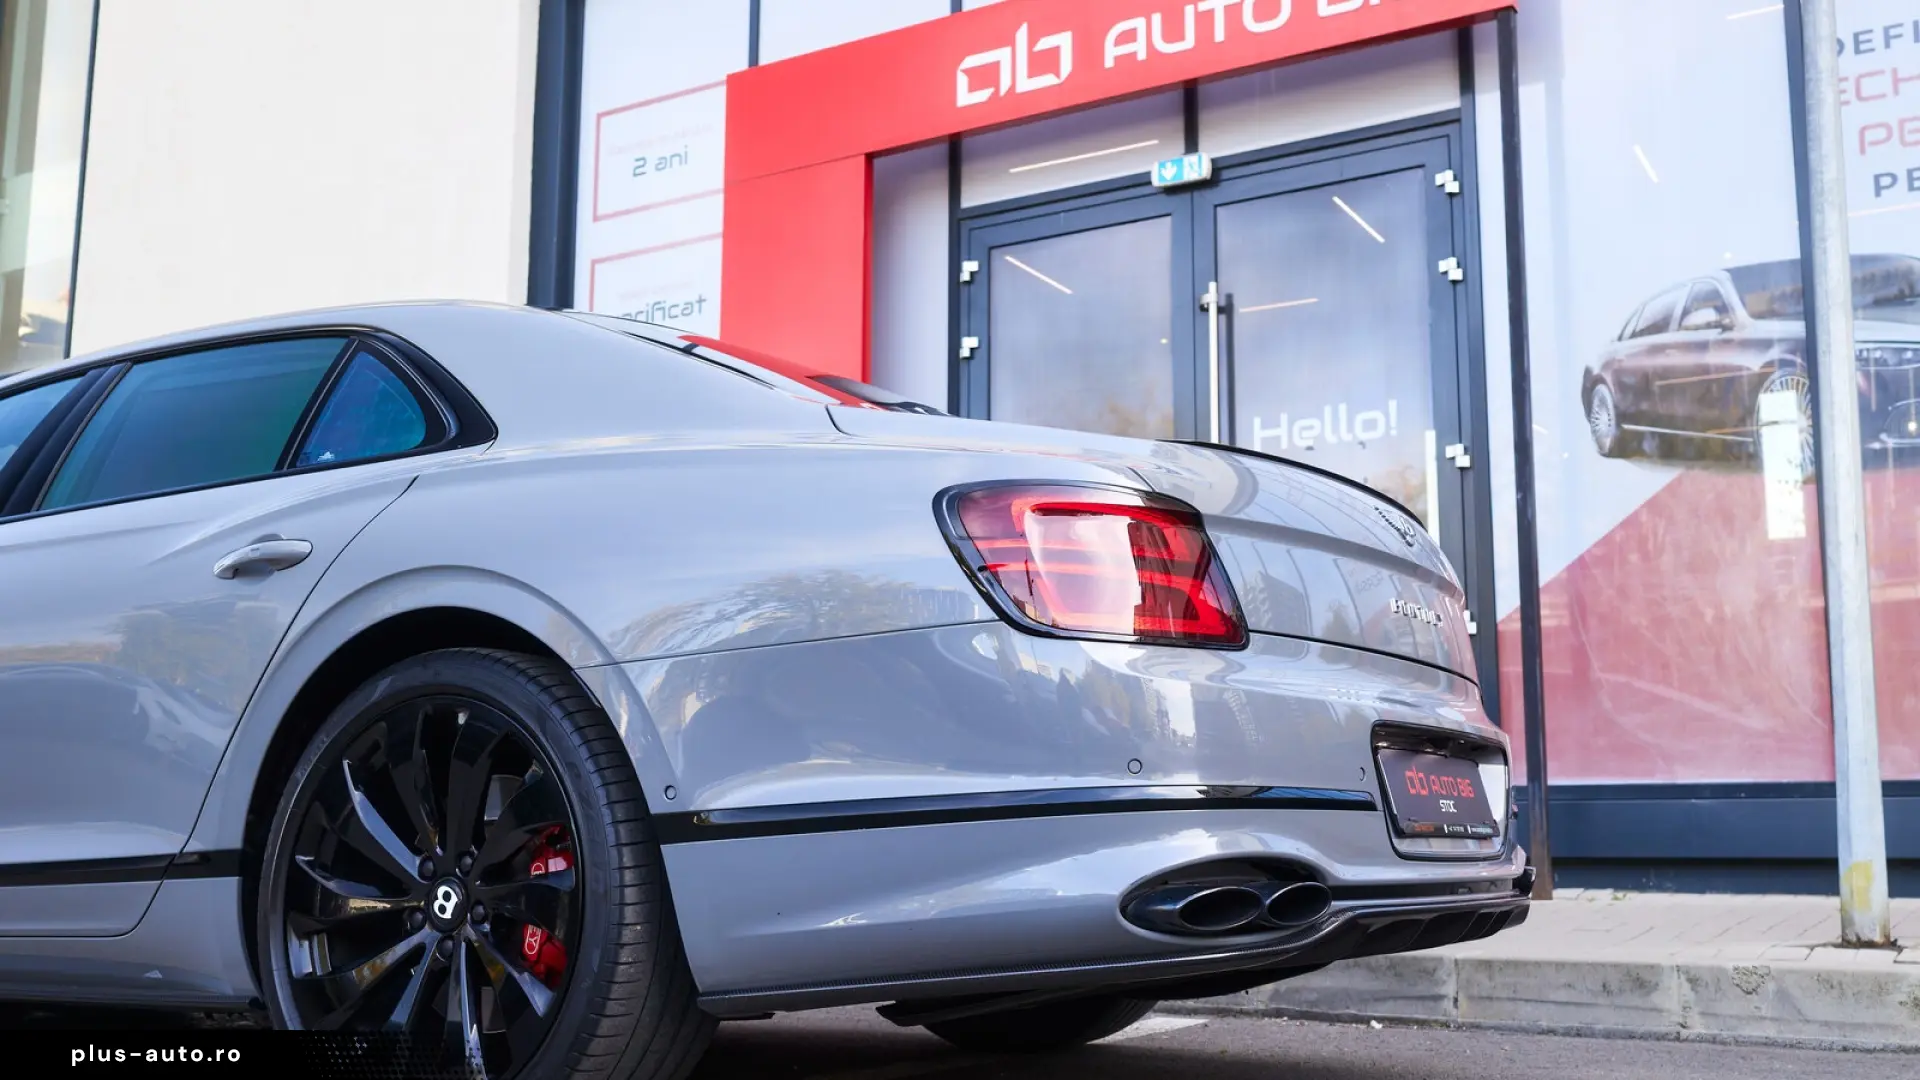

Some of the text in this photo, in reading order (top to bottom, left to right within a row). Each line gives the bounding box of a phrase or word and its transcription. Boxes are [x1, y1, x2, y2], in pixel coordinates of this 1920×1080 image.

[1104, 0, 1292, 68] AUTO
[632, 145, 688, 178] 2 ani
[1253, 399, 1398, 452] Hello!
[1429, 775, 1458, 797] AUTO
